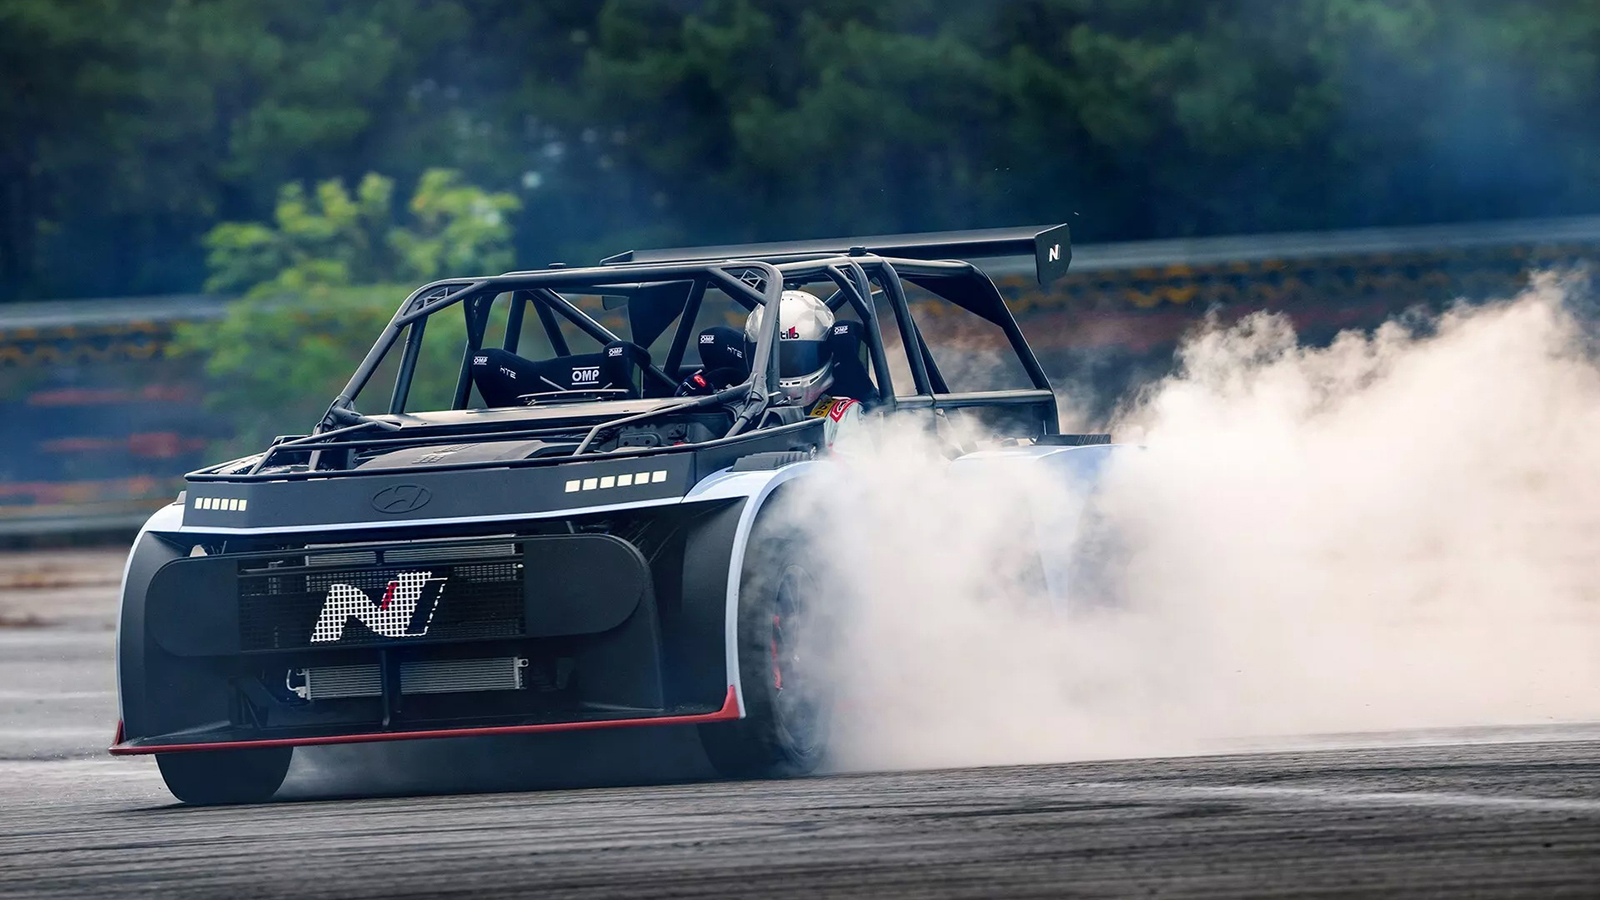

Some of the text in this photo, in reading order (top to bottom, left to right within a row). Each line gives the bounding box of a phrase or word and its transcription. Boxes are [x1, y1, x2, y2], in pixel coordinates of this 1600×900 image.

[1049, 244, 1060, 262] N
[780, 326, 800, 339] tilo
[572, 369, 600, 382] OMP
[310, 571, 448, 642] N
